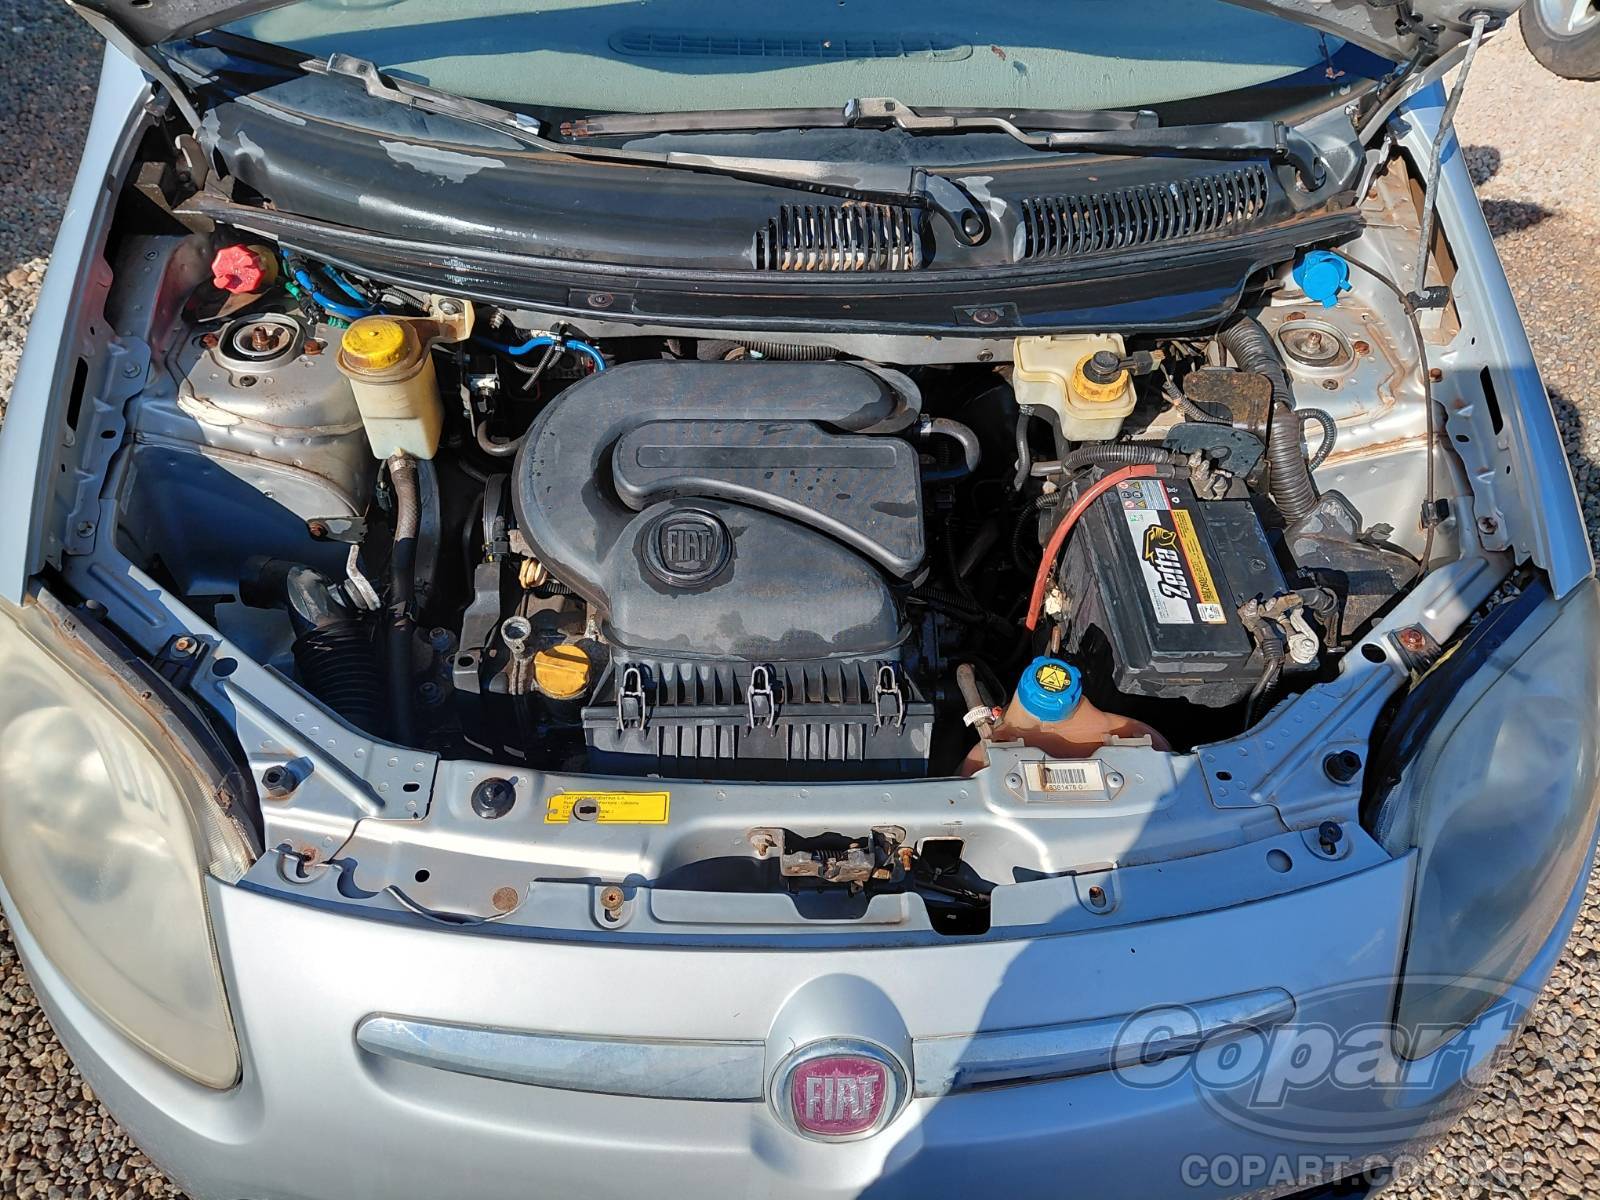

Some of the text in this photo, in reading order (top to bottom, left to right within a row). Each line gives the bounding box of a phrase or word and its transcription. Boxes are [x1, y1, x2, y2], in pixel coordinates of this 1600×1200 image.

[667, 530, 711, 561] FIAT
[1154, 547, 1192, 599] Zetta
[806, 1075, 879, 1121] FIAT
